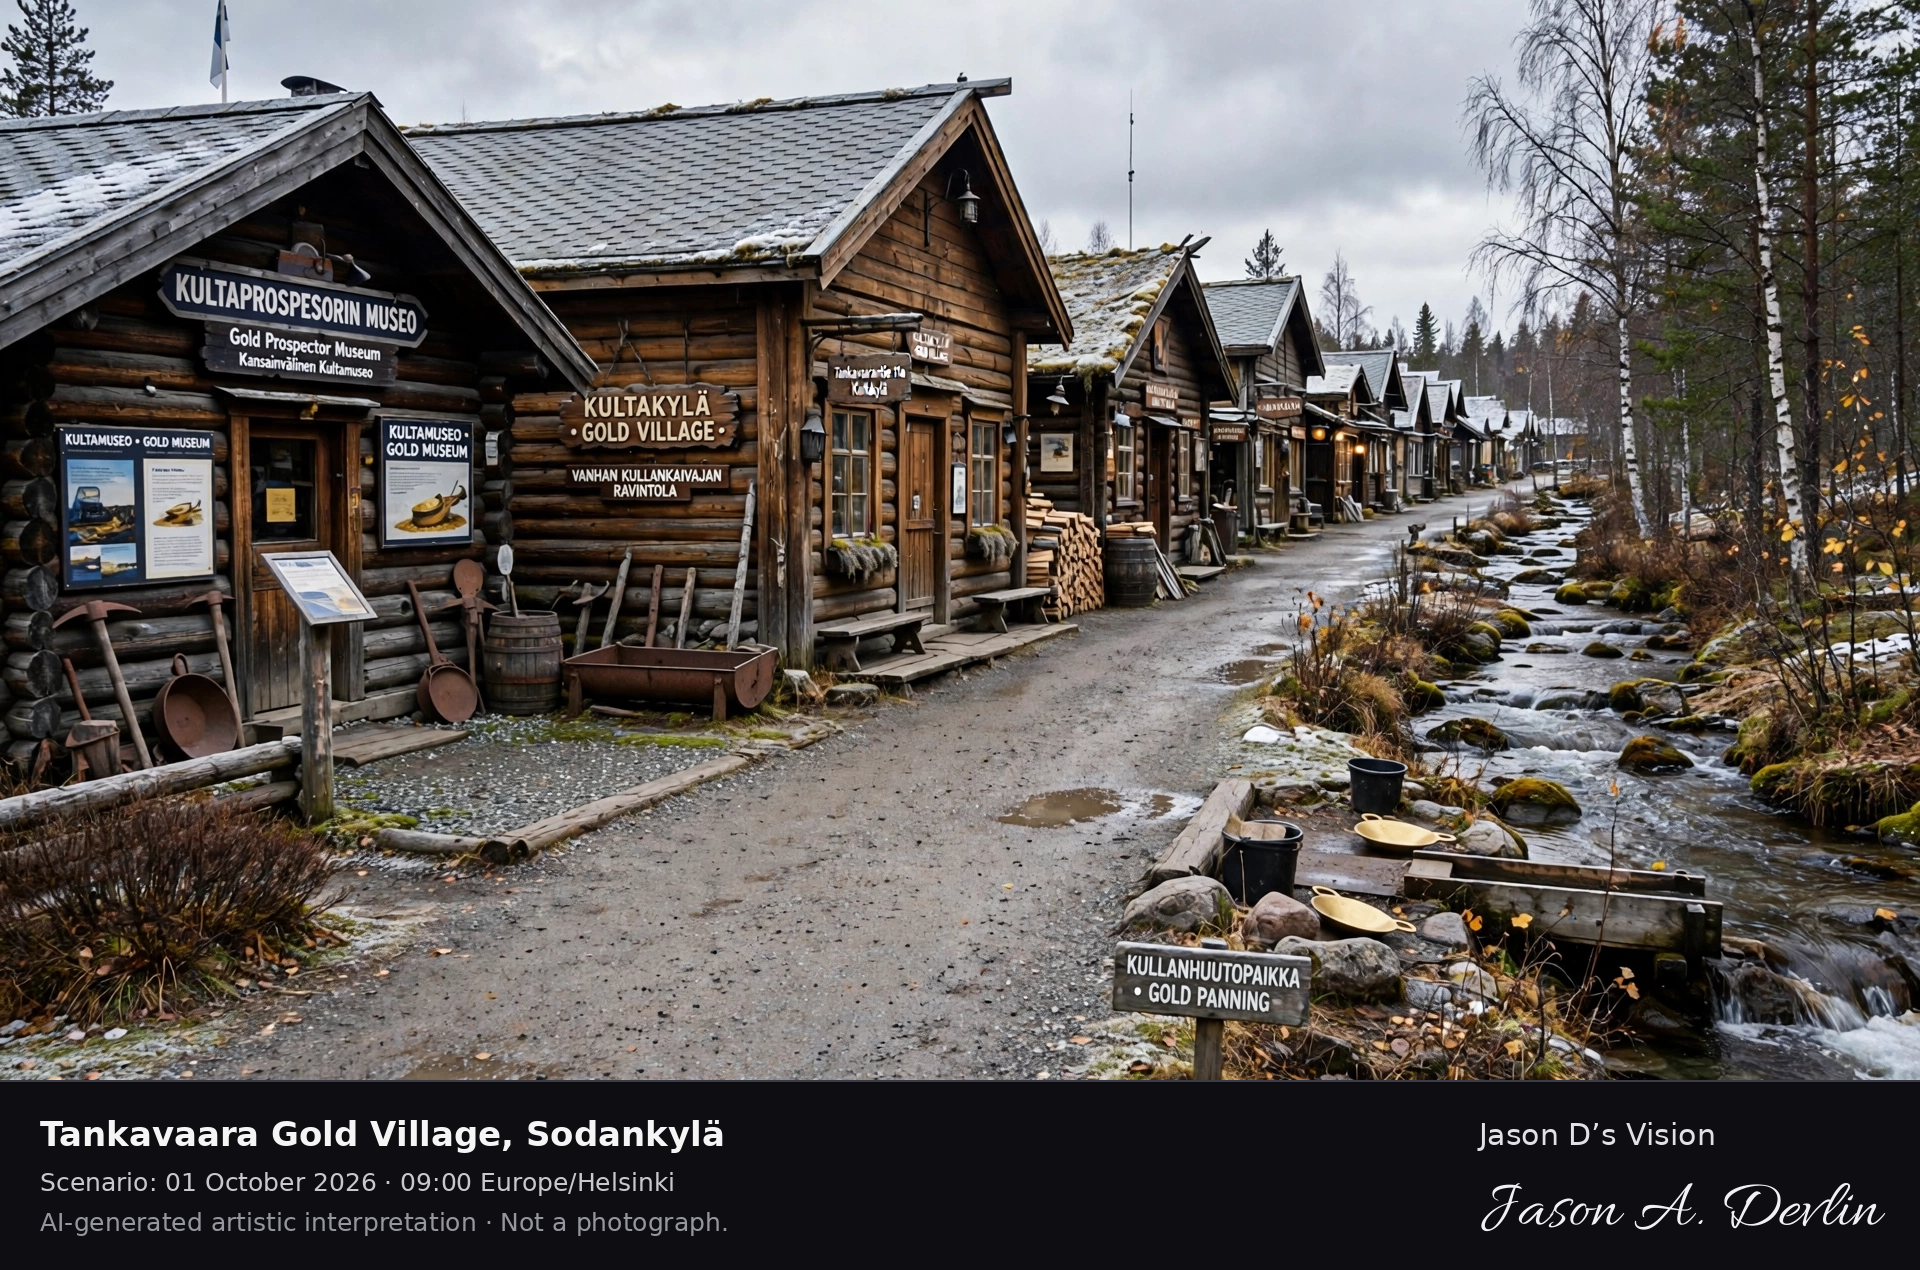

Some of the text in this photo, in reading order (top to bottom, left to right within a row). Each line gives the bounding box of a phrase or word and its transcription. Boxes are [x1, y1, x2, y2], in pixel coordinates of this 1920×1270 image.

[175, 272, 417, 335] KULTAPROSPESORIN MUSEO
[229, 327, 381, 361] Gold Prospector Museum
[239, 352, 373, 379] Kansainvälinen Kultamuseo
[584, 389, 711, 418] KULTAKYLÄ
[65, 433, 210, 449] KULTAMUSEO GOLD MUSEUM
[389, 424, 462, 442] KULTAMUSEO
[582, 420, 715, 443] GOLD VILLAGE
[386, 442, 468, 459] GOLD MUSEUM
[572, 468, 722, 483] VANHAN KULLANKAIVAJAN
[613, 484, 677, 497] RAVINTOLA
[1127, 954, 1300, 989] KULLANHUUTOPAIKKA
[1149, 982, 1270, 1012] GOLD PANNING
